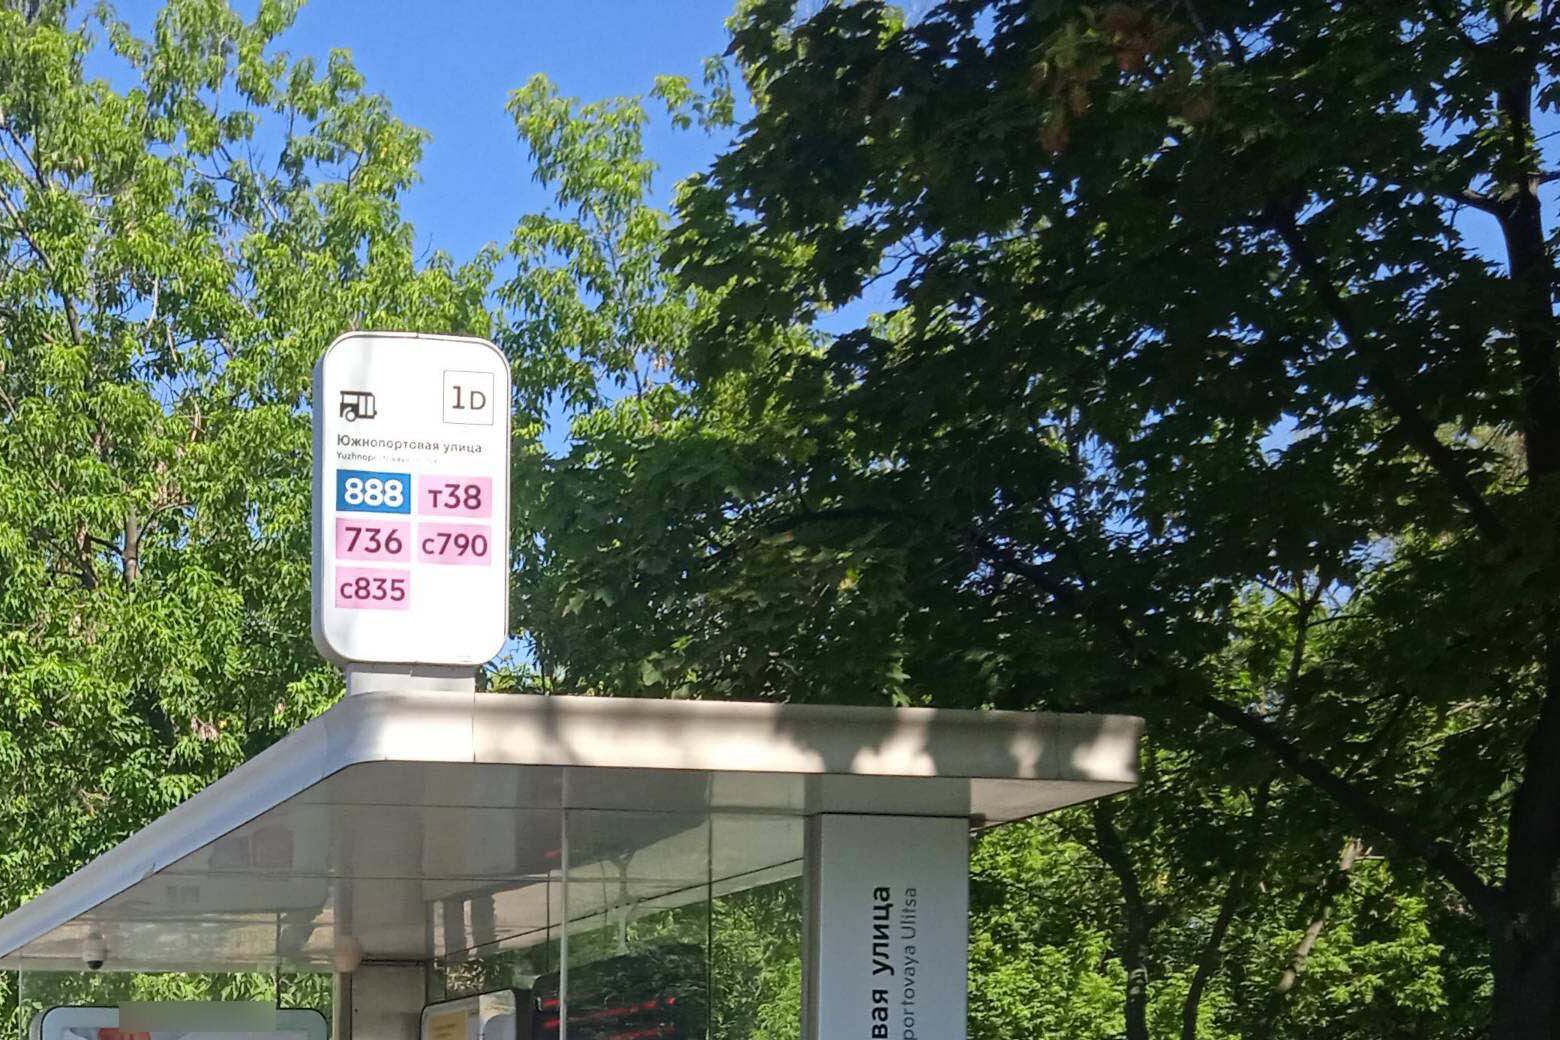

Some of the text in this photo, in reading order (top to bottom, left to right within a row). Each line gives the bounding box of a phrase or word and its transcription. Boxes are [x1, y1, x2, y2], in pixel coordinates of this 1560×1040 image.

[452, 385, 486, 411] 1D
[337, 434, 483, 454] Южнопортовая улица
[344, 477, 404, 507] 888
[428, 484, 481, 510] т38
[344, 526, 403, 554] 736
[421, 533, 488, 557] с790
[340, 576, 406, 601] с835
[902, 887, 918, 940] Ulitsa
[873, 886, 895, 976] улица
